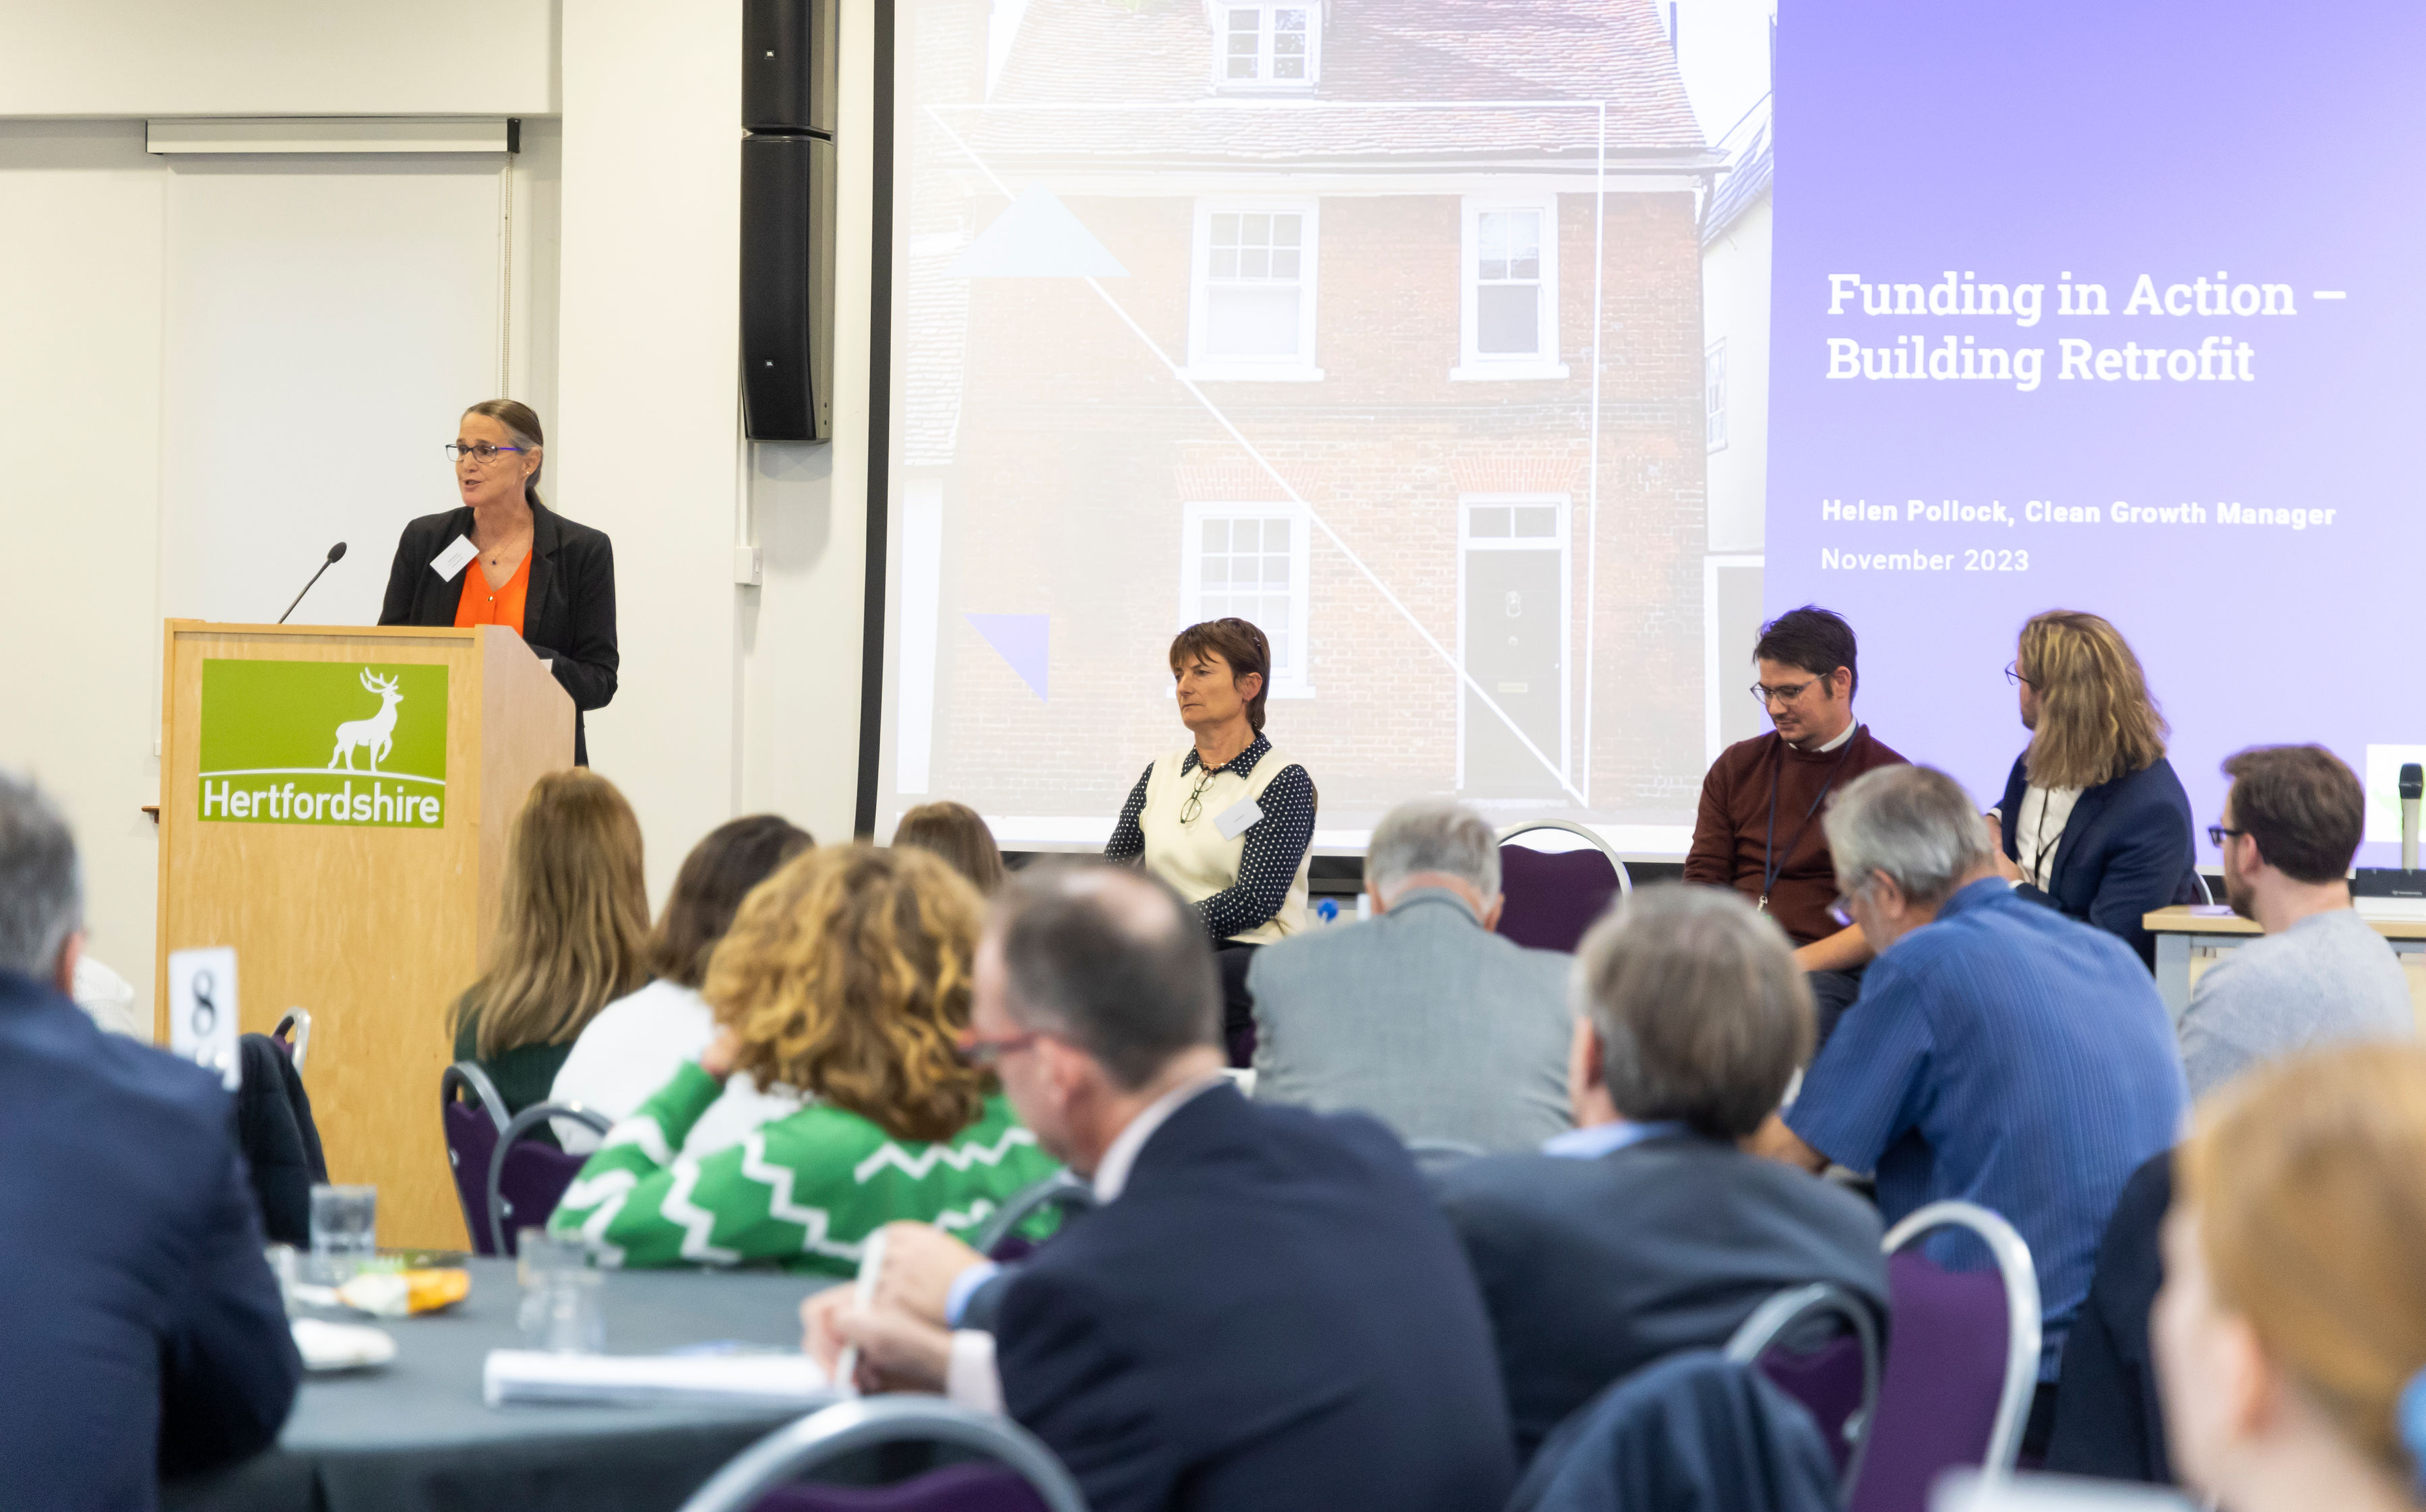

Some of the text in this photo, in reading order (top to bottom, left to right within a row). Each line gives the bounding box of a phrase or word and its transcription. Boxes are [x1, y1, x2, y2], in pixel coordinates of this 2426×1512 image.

[1827, 271, 2045, 327] Funding
[2057, 271, 2110, 315] in
[2123, 270, 2297, 316] Action
[1826, 335, 2255, 391] Building Retrofit
[1822, 499, 2337, 530] Helen Pollock, Clean Growth Manager
[1822, 548, 2029, 571] November 2023
[204, 780, 440, 823] Hertfordshire
[191, 968, 217, 1038] 8
